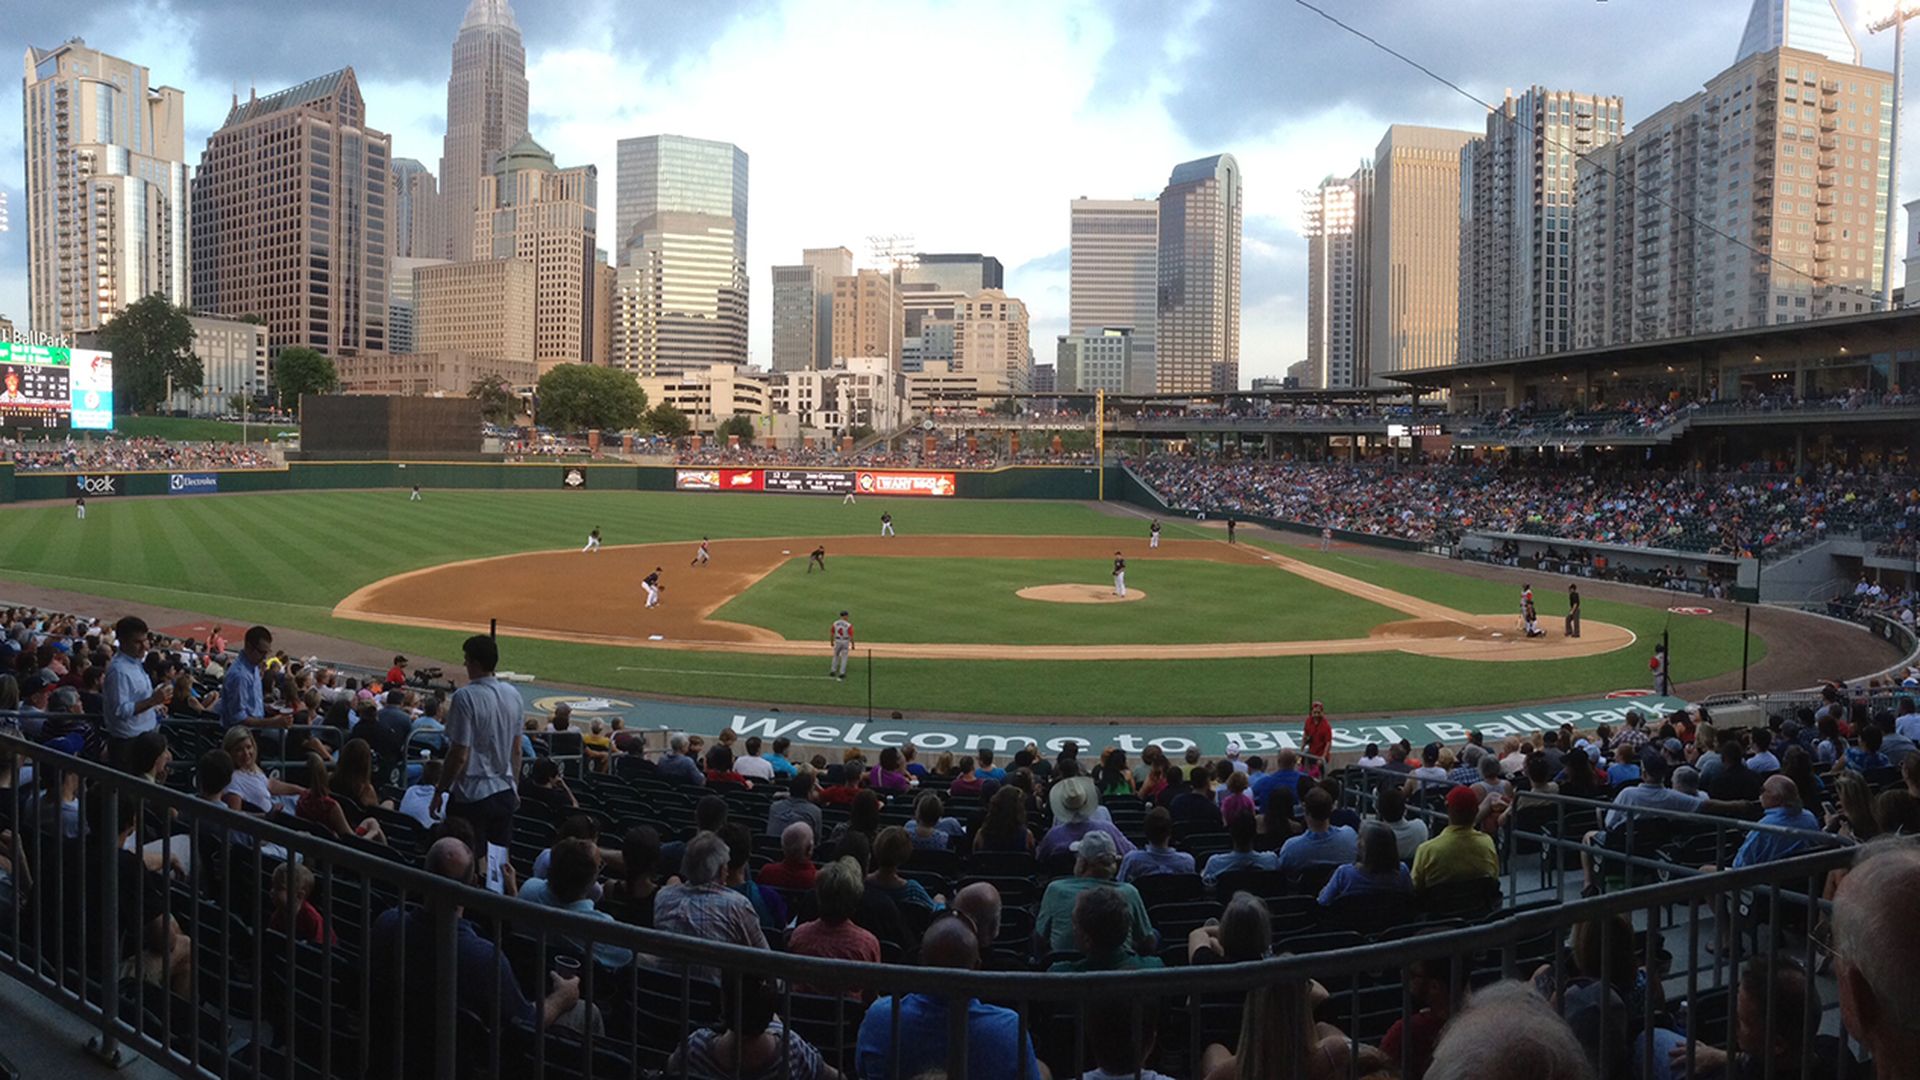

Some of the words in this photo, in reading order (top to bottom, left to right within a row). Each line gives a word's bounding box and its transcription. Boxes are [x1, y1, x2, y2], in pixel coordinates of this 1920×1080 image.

[13, 329, 68, 348] BallPark
[184, 476, 217, 486] Electrolux
[837, 627, 845, 637] 4
[731, 714, 1091, 753] Welcome
[1113, 734, 1197, 753] to
[1424, 700, 1678, 741] BallPark
